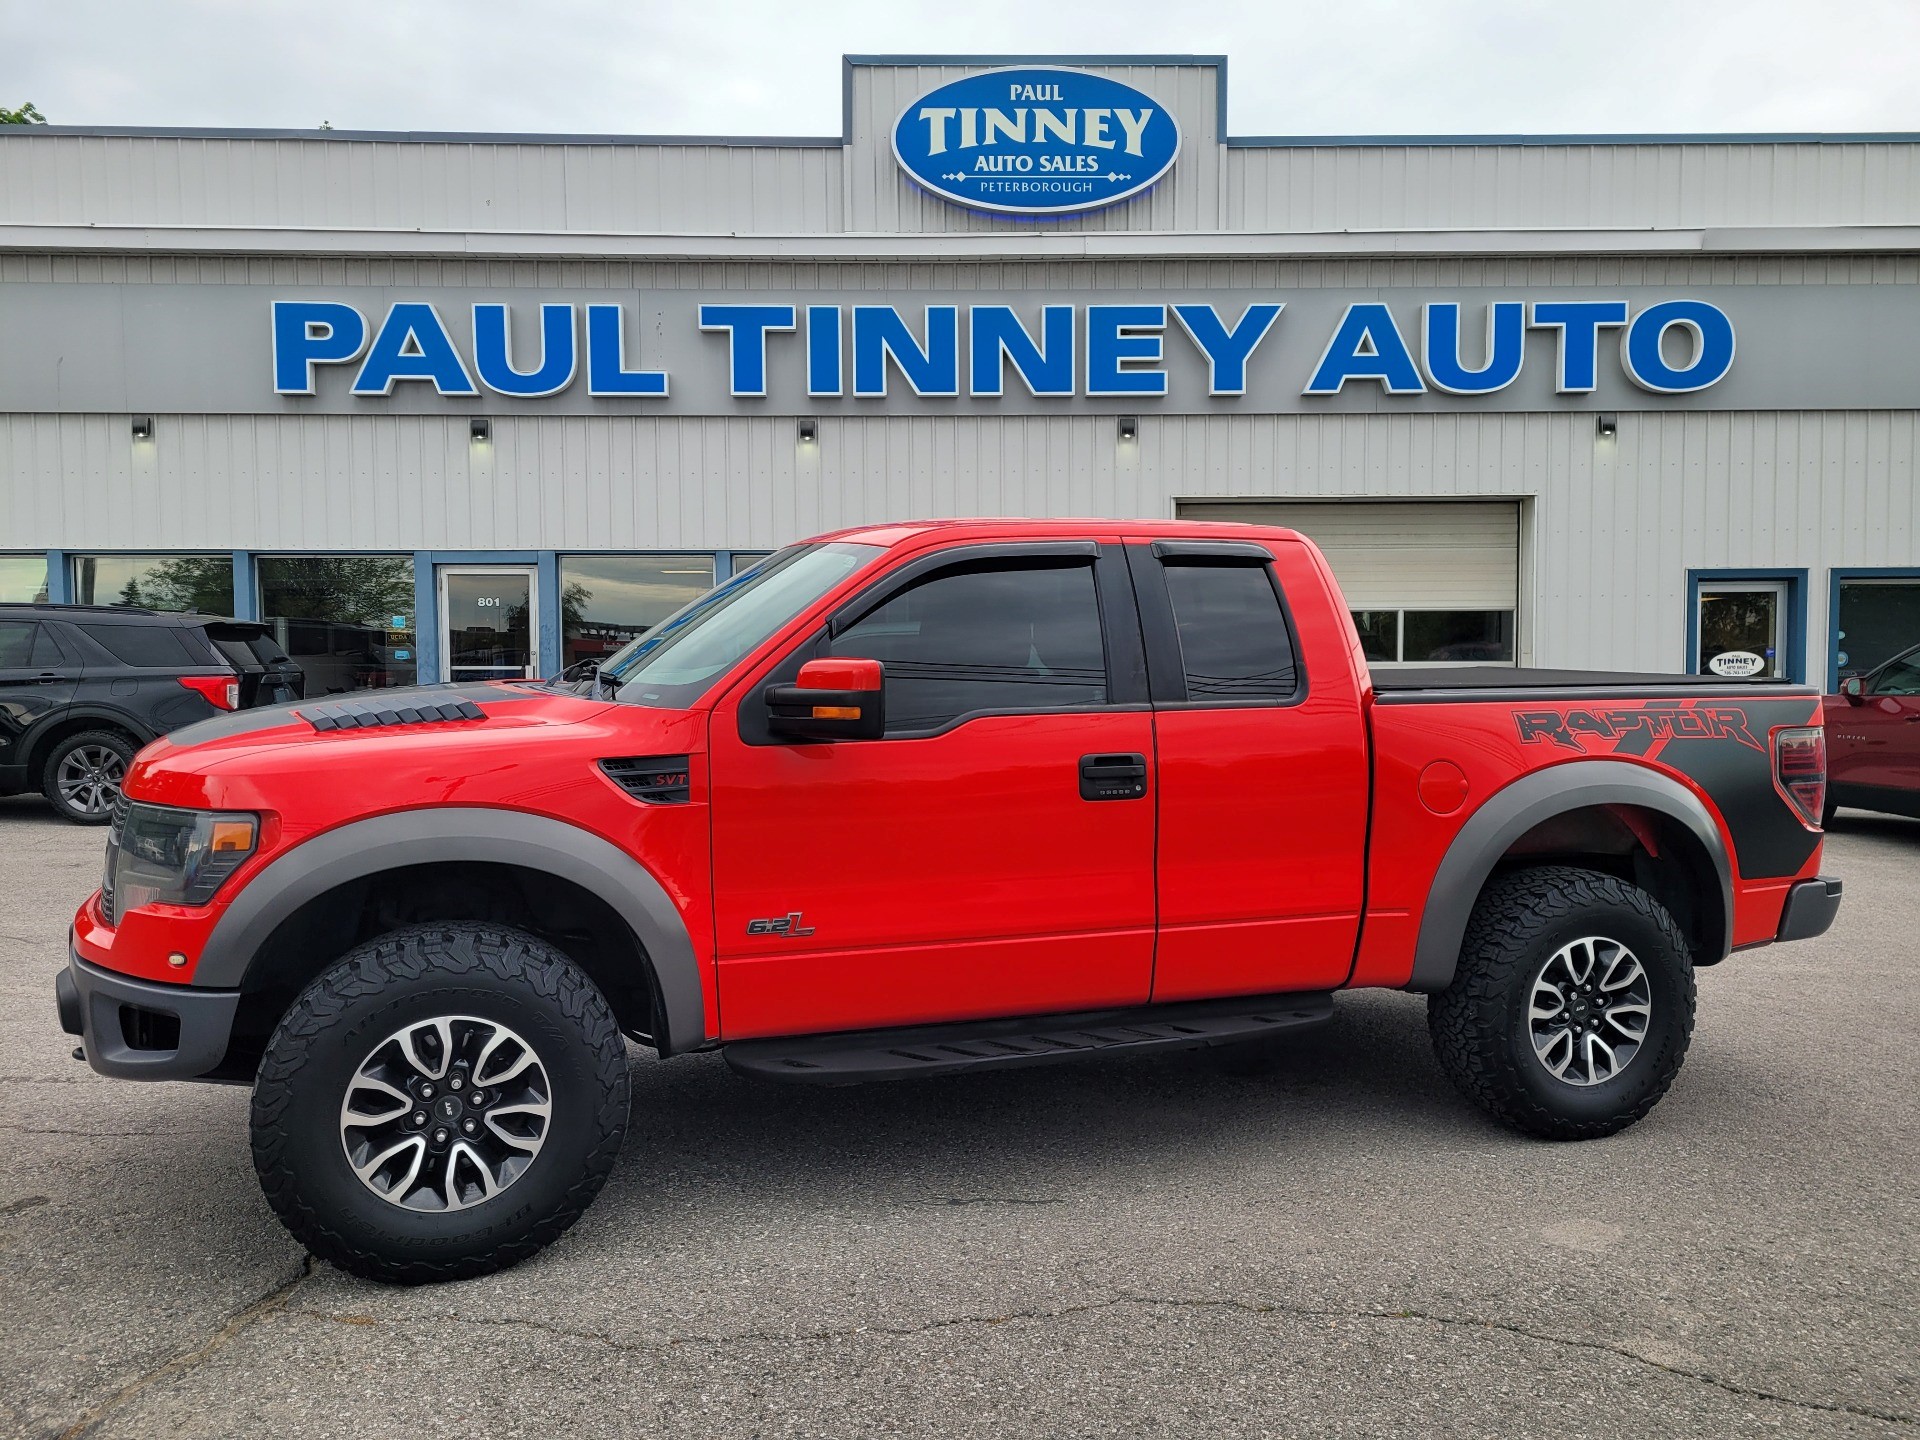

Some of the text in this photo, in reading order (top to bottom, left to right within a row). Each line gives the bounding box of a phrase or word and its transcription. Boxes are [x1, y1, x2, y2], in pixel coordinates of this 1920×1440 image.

[1010, 84, 1064, 101] PAUL
[919, 107, 1154, 158] TINNEY
[973, 155, 1099, 172] AUTO SALES
[980, 182, 1093, 193] PETERBOROUGH
[270, 299, 1737, 398] PAUL TINNEY AUTO
[477, 597, 500, 607] 801
[1716, 658, 1757, 667] TINNEY
[1511, 708, 1766, 754] RAPTOR
[656, 774, 687, 785] SVT
